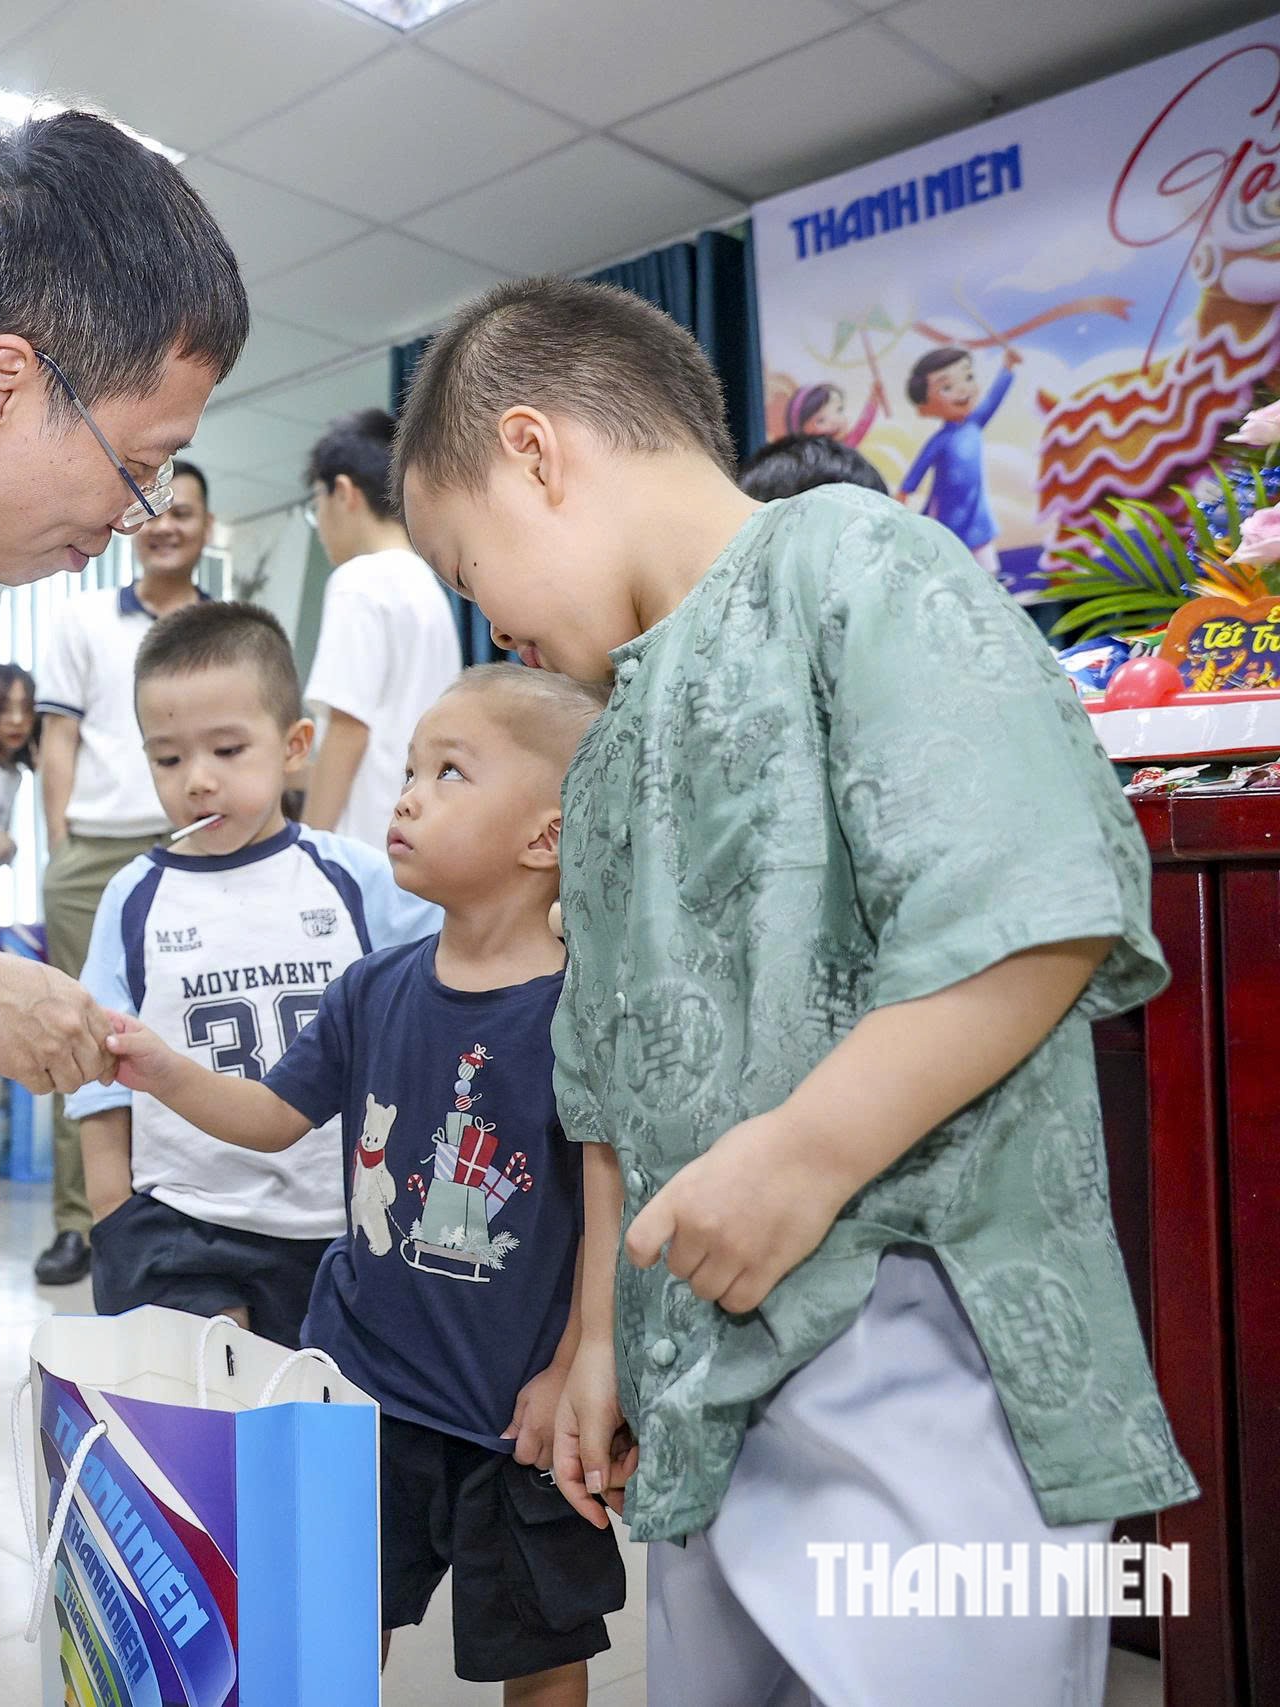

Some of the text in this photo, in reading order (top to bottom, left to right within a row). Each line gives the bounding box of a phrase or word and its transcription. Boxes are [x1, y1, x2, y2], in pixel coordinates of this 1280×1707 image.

[789, 179, 921, 260] THANH
[1203, 621, 1247, 650] Tết
[182, 961, 332, 999] MOVEMENT
[64, 1577, 98, 1666] THANH
[124, 1524, 210, 1649] NIÊN
